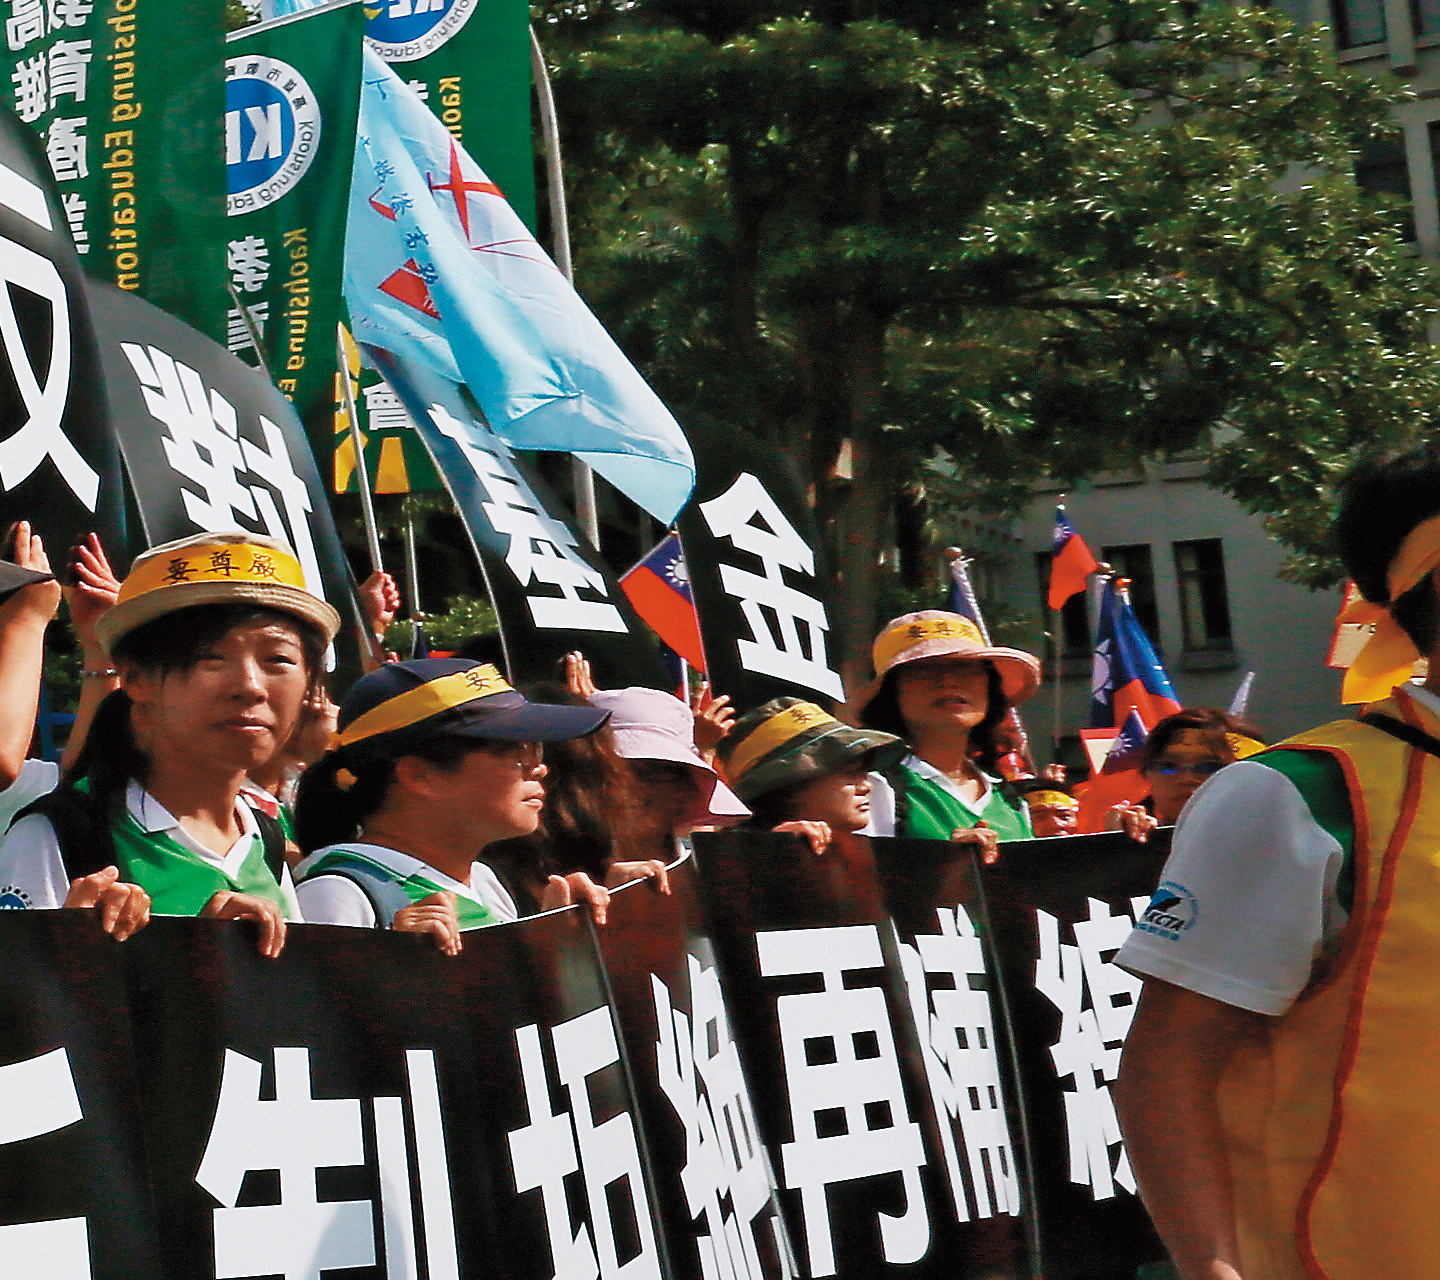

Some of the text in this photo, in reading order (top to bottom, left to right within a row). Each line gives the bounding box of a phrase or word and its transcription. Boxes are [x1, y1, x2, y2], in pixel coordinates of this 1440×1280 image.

[162, 549, 282, 585] 要尊嚴
[699, 473, 846, 704] 金
